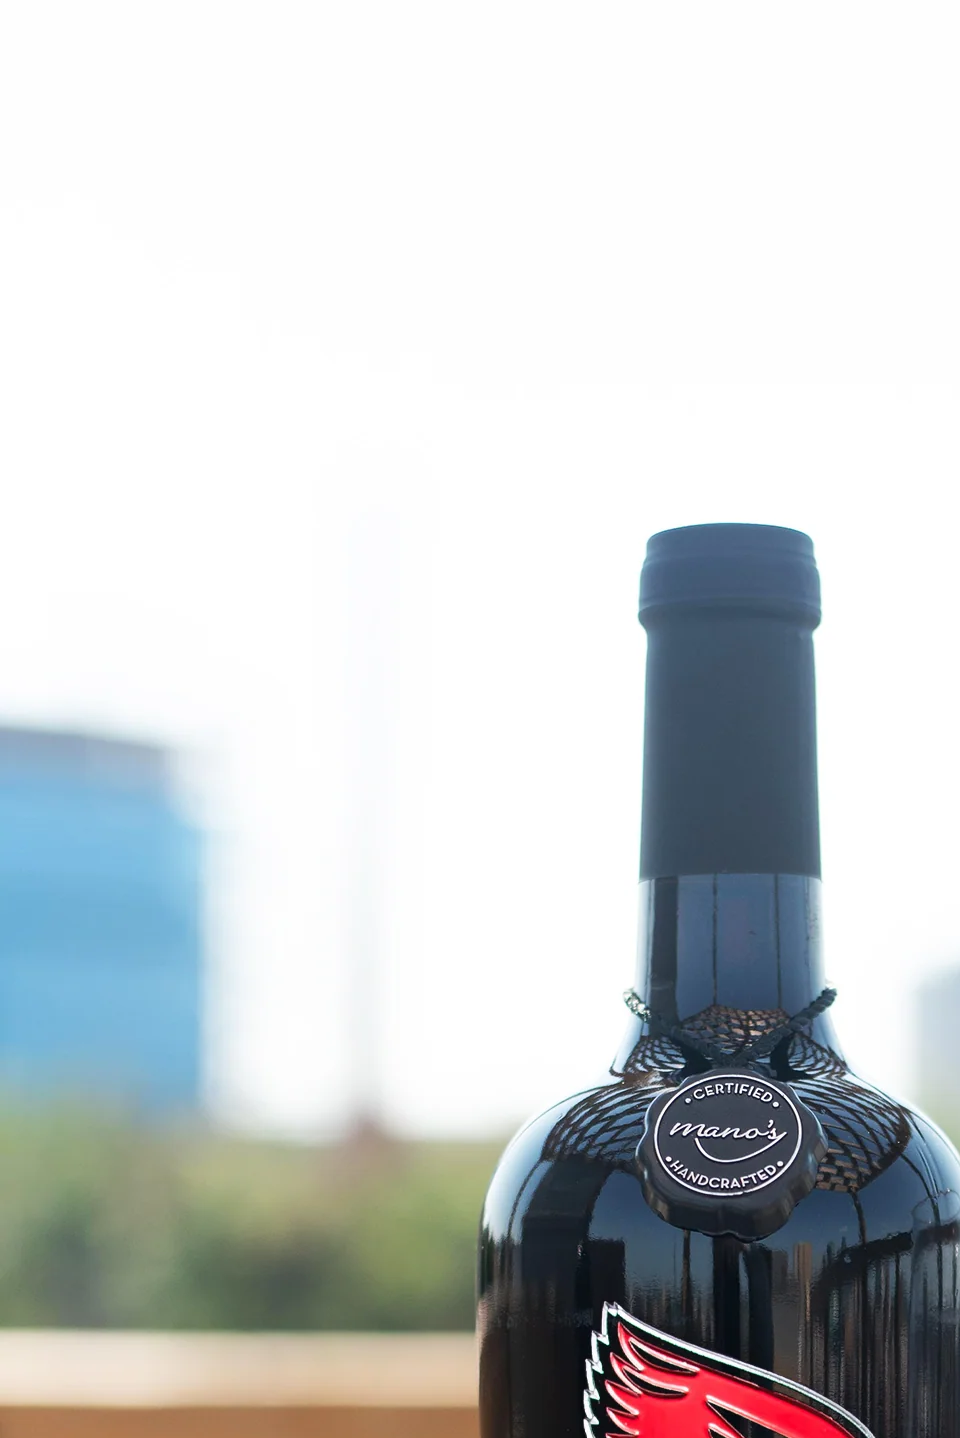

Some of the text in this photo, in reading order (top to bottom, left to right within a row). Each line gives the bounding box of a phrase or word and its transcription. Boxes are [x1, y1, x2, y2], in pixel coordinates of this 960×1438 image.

[693, 1083, 773, 1103] CERTIFIED
[669, 1119, 788, 1163] mano's
[670, 1160, 777, 1189] HANDCRAFTED
